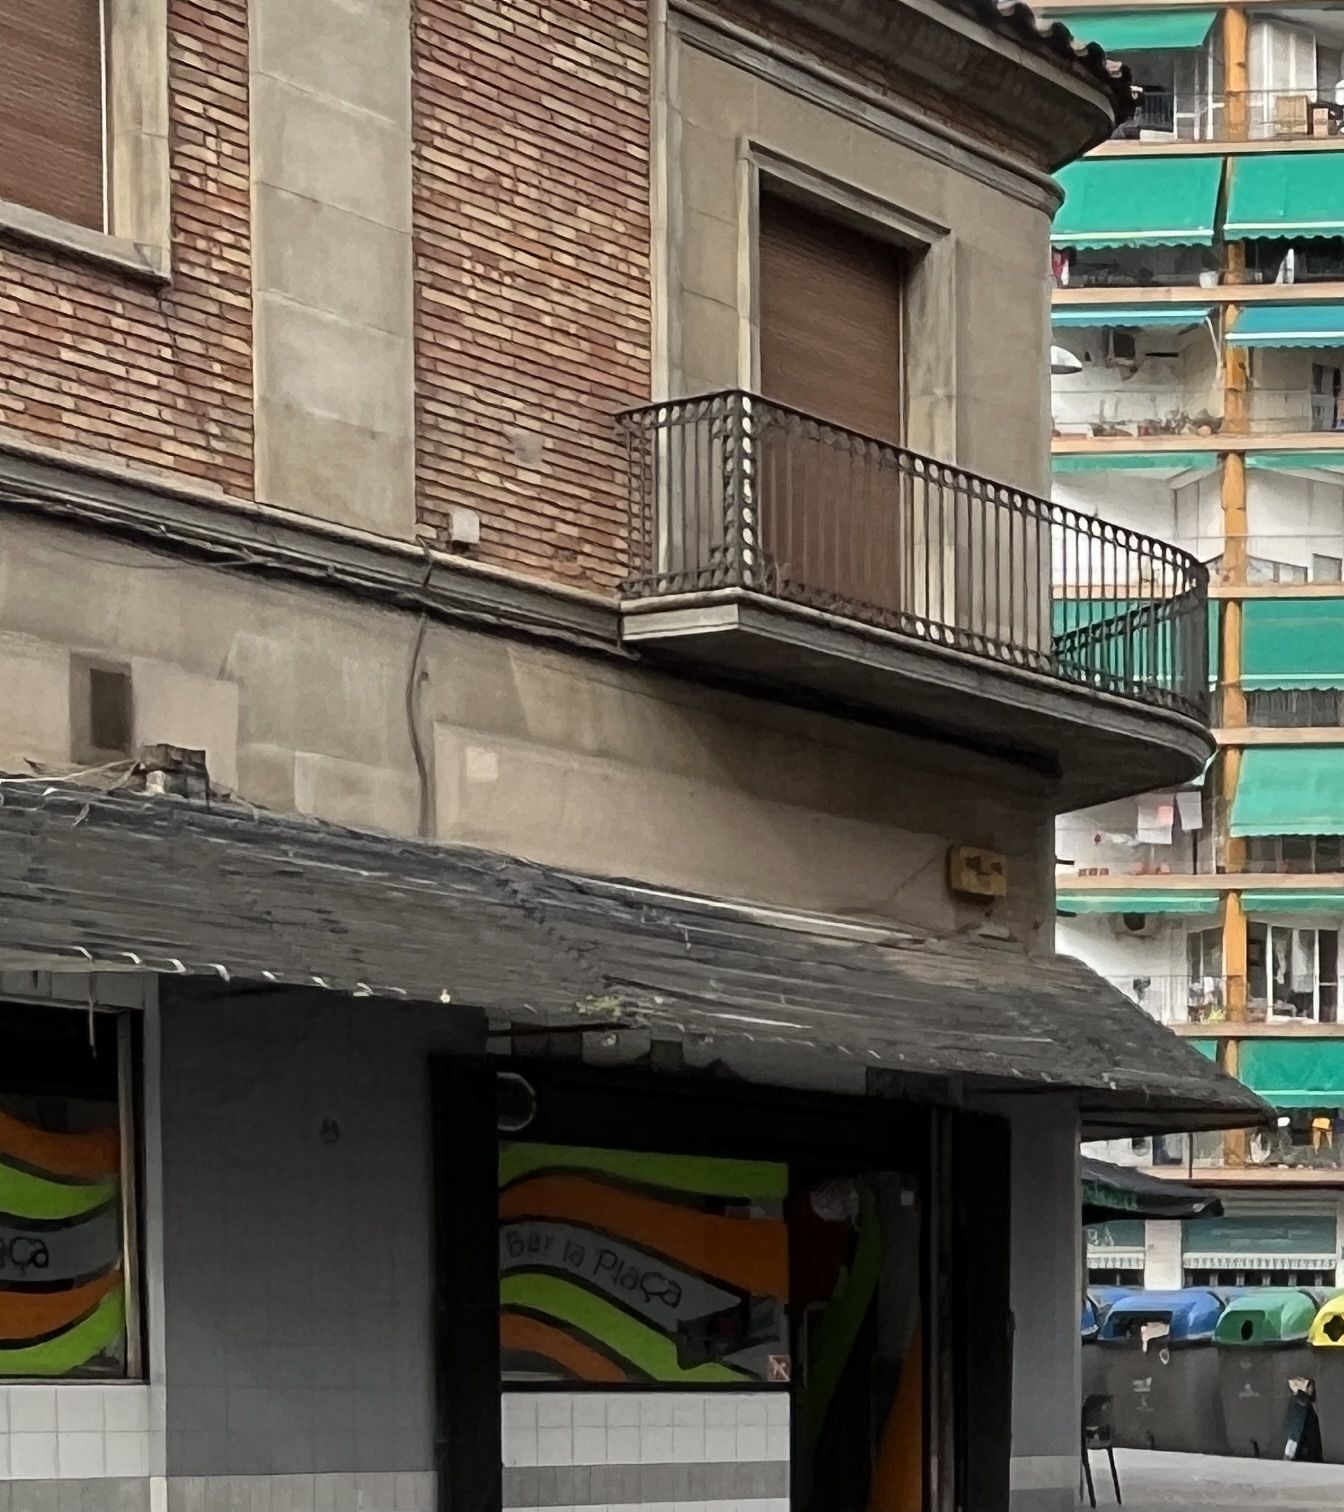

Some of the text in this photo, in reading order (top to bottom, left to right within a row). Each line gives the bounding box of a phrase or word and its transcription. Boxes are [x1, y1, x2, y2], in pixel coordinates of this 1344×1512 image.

[505, 1231, 682, 1308] Bar la Plaça
